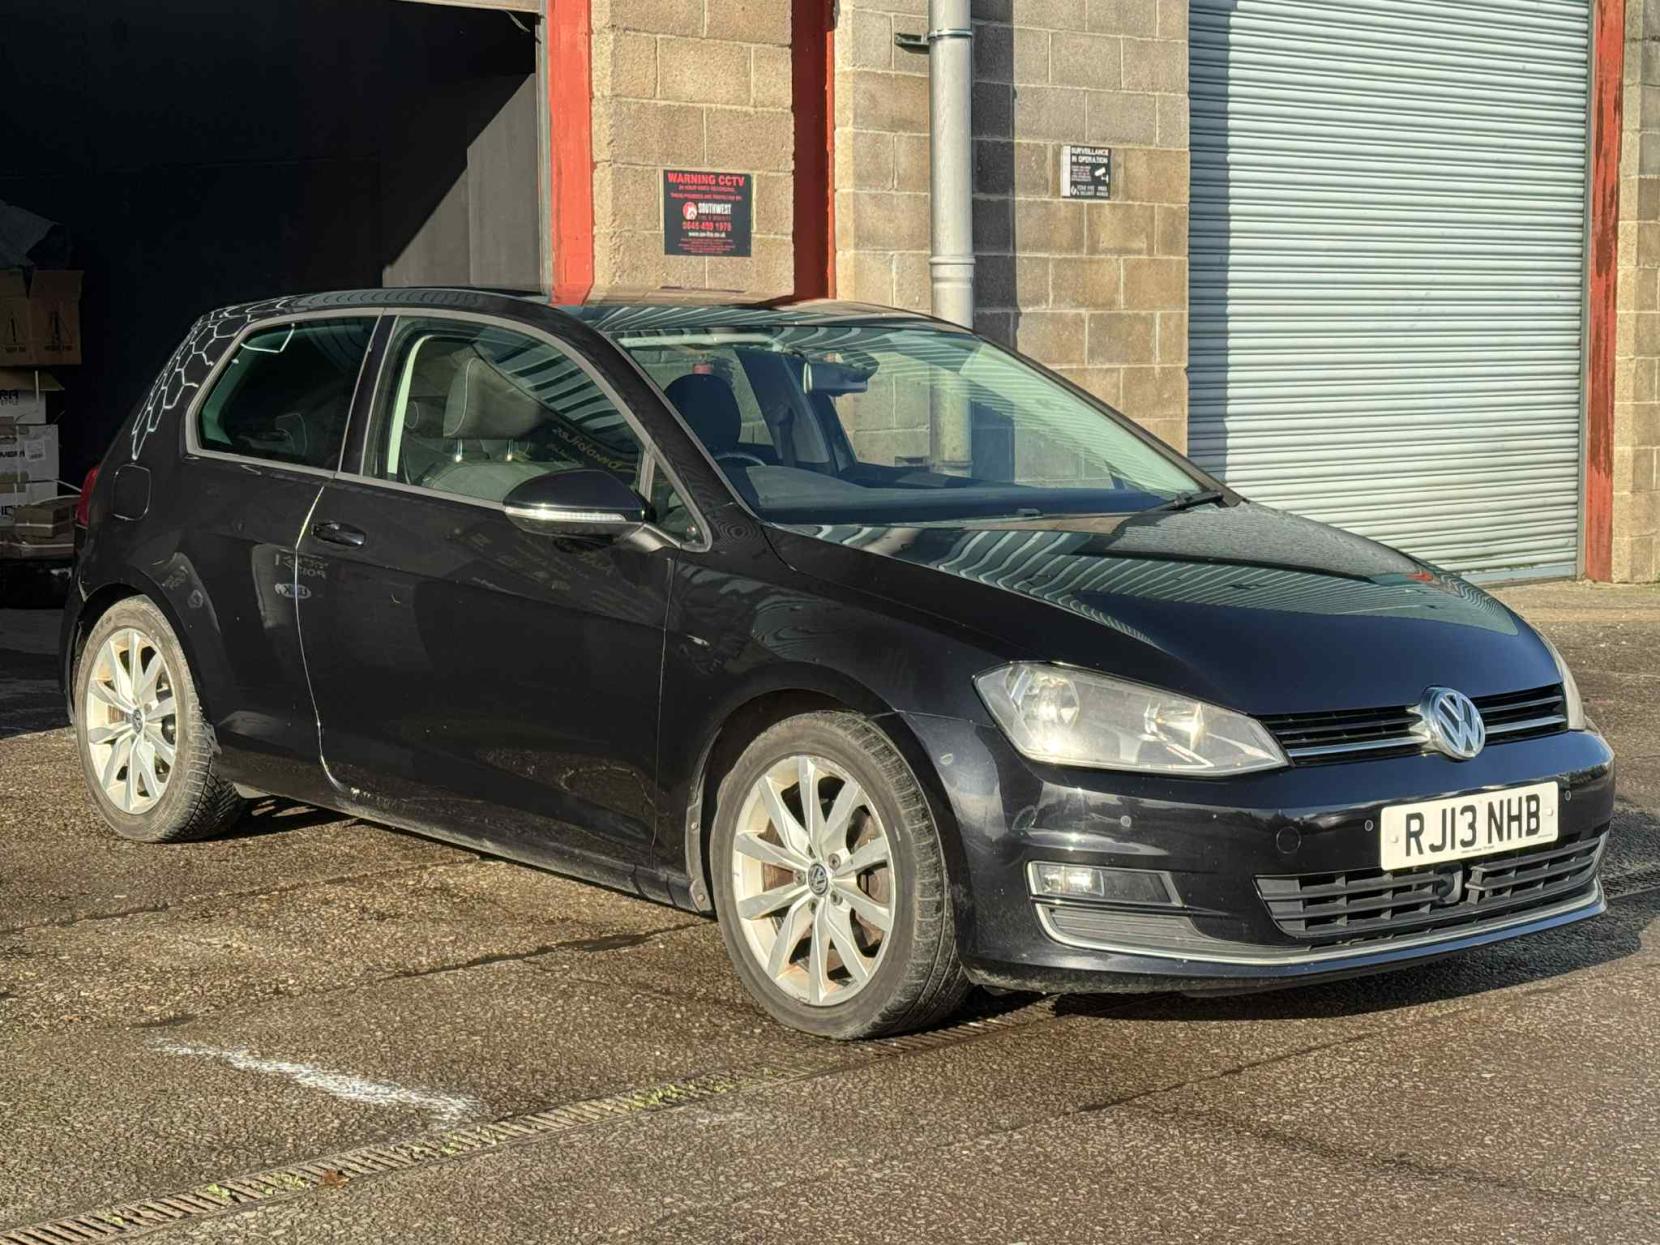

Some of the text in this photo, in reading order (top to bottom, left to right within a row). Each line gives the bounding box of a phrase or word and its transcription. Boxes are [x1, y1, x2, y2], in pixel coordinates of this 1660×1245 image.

[1071, 147, 1109, 156] SURVEILLANCE
[1071, 155, 1108, 164] IN OPERATION
[667, 172, 745, 187] WARNING CCTV
[698, 203, 732, 215] SOUTHWEST
[1405, 793, 1541, 857] RJ13 NHB
